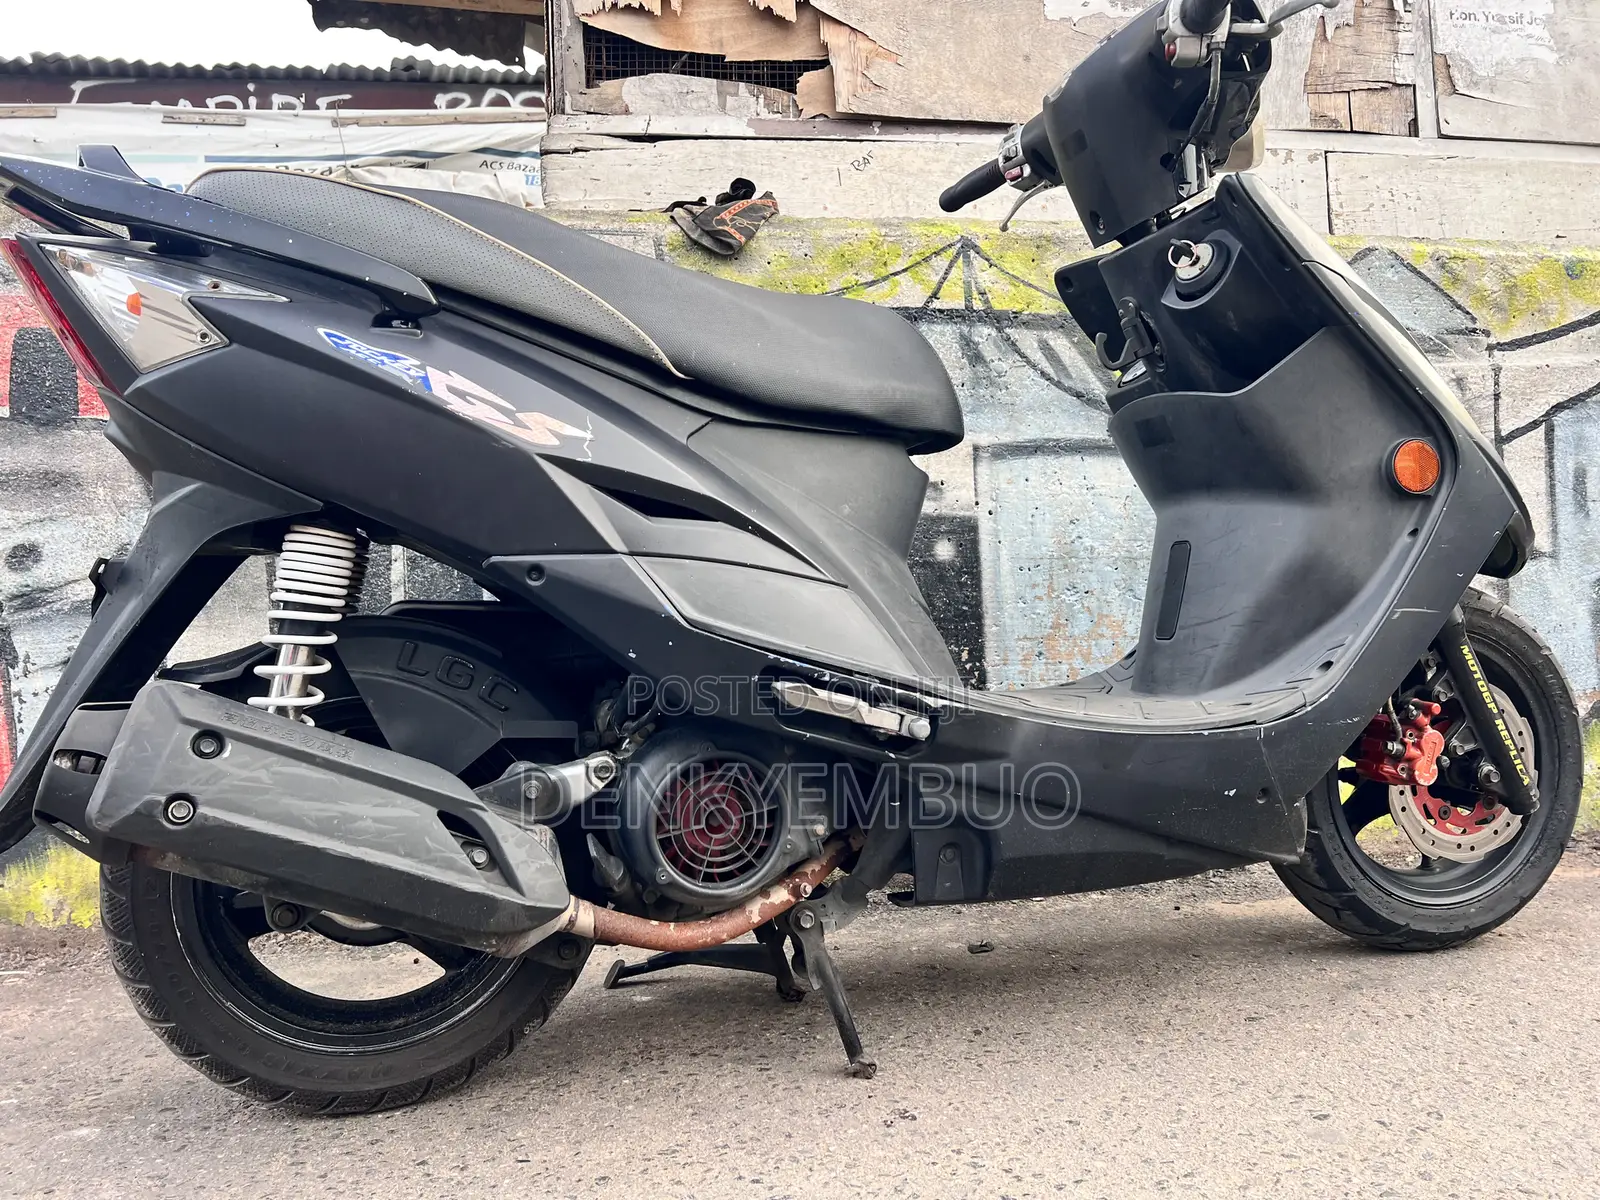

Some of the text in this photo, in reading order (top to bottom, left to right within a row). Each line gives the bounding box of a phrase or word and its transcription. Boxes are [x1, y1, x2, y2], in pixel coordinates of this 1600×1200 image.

[479, 159, 505, 171] ACS
[396, 640, 519, 712] LGC
[1460, 644, 1531, 787] MOTOGP REPLICA
